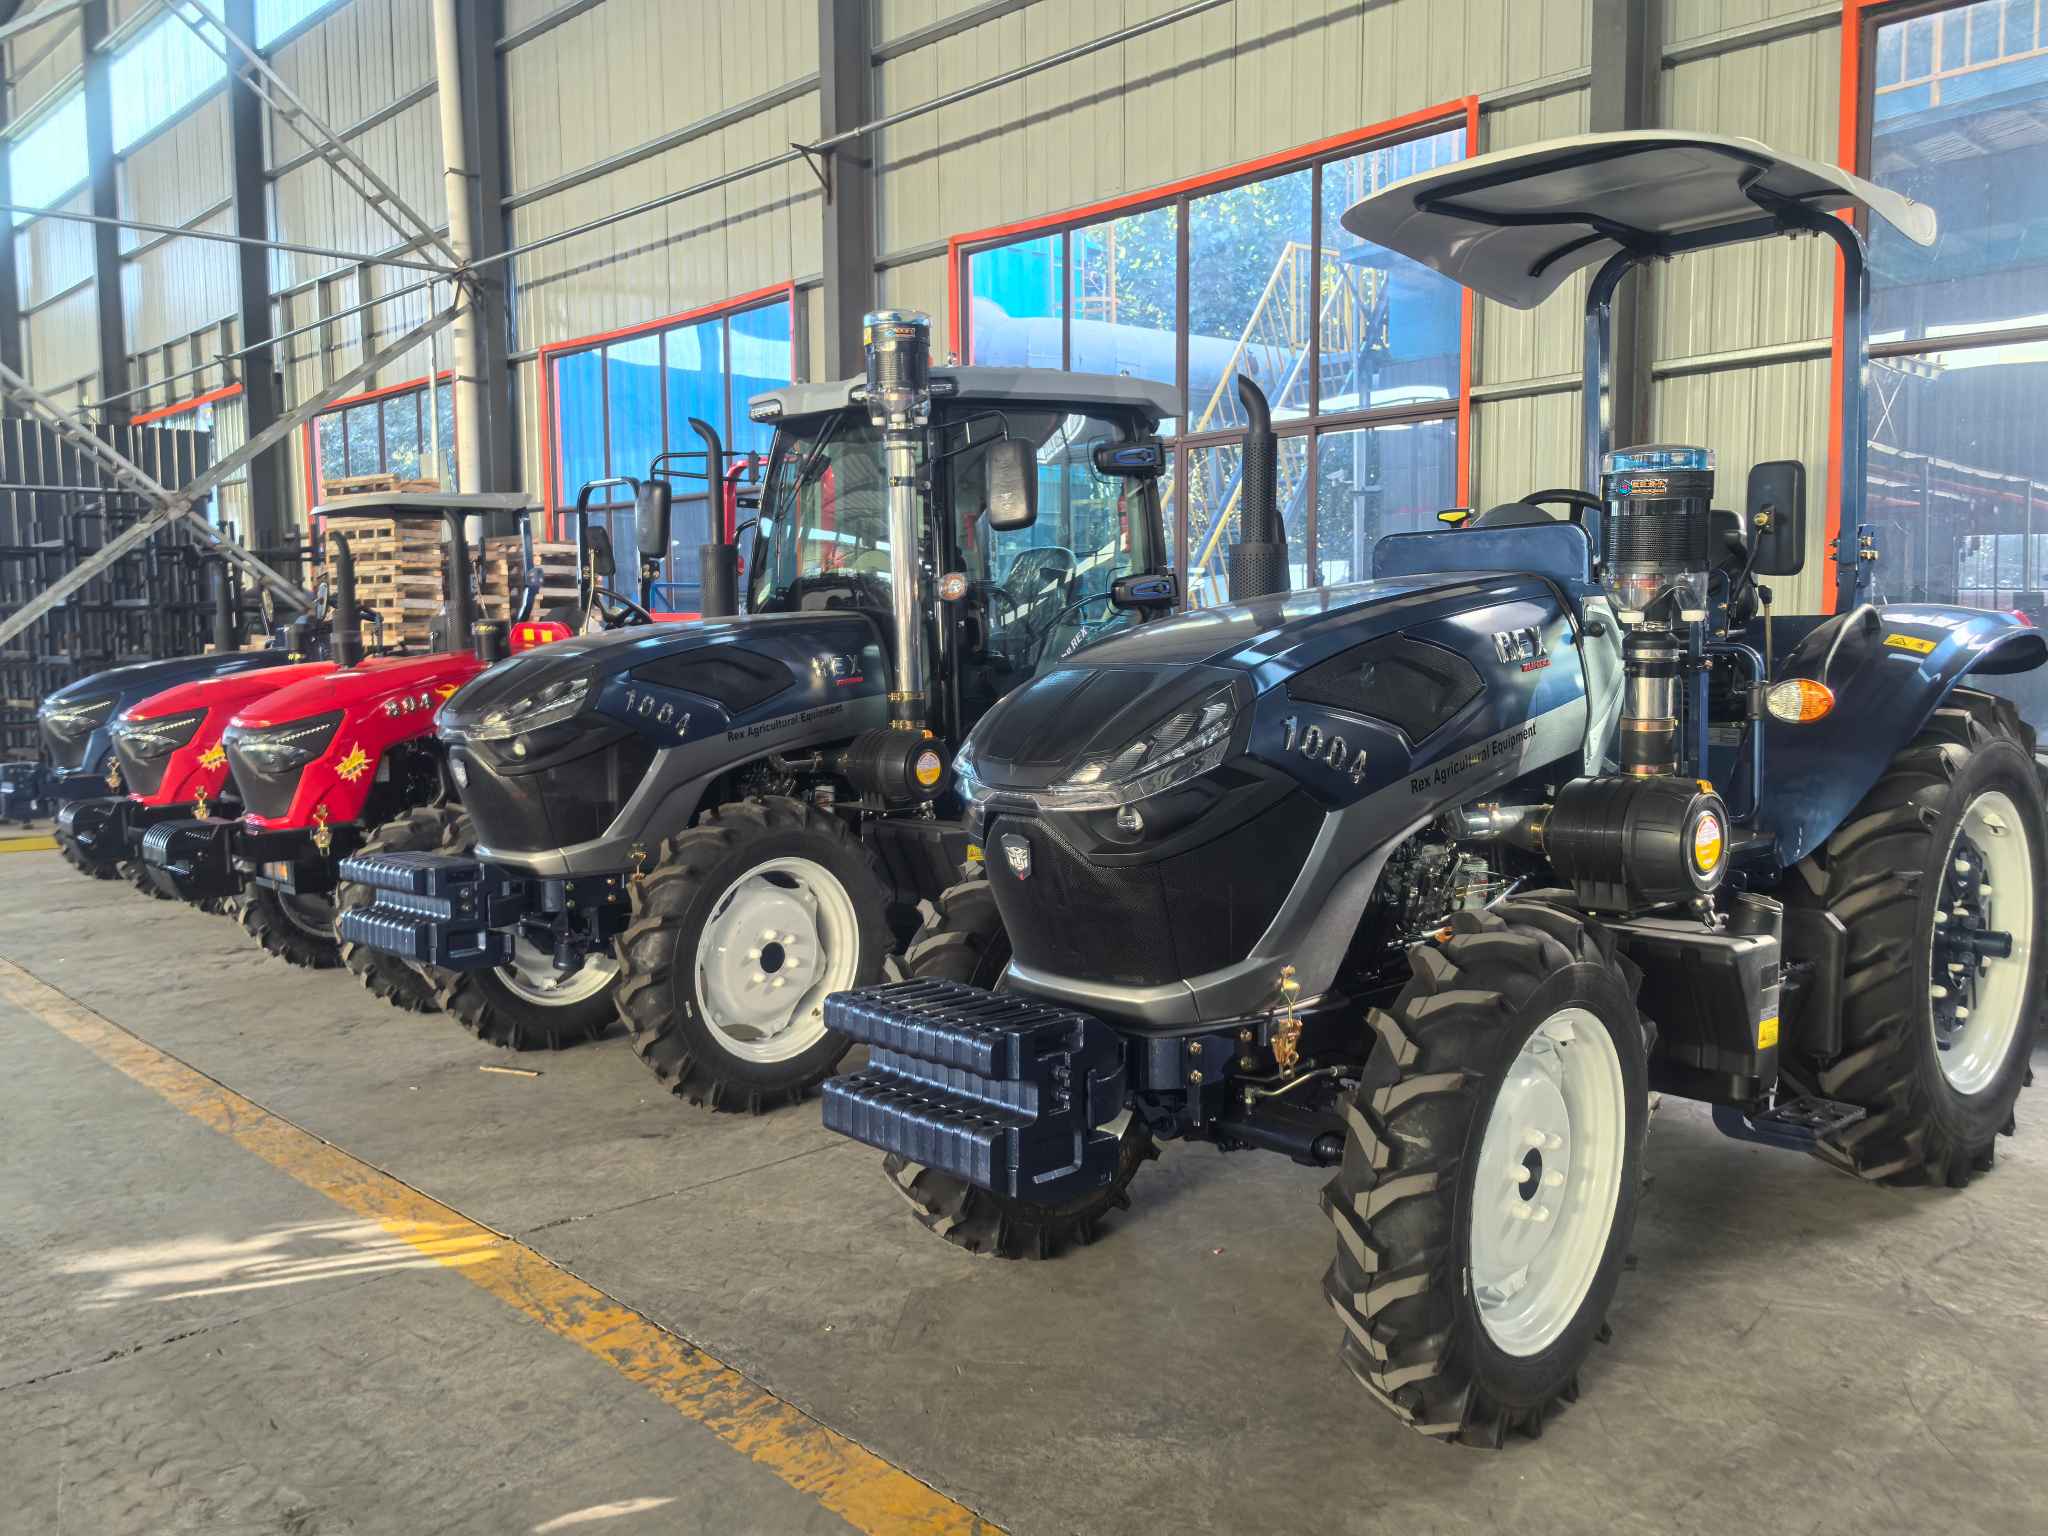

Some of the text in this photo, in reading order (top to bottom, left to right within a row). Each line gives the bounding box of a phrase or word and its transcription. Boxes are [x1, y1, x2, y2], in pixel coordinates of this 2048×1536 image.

[1492, 626, 1547, 662] REX
[728, 731, 744, 743] Rex
[748, 716, 798, 737] Agricultural
[1284, 715, 1367, 784] 1004
[1411, 721, 1537, 794] Rex Agricultural Equipment
